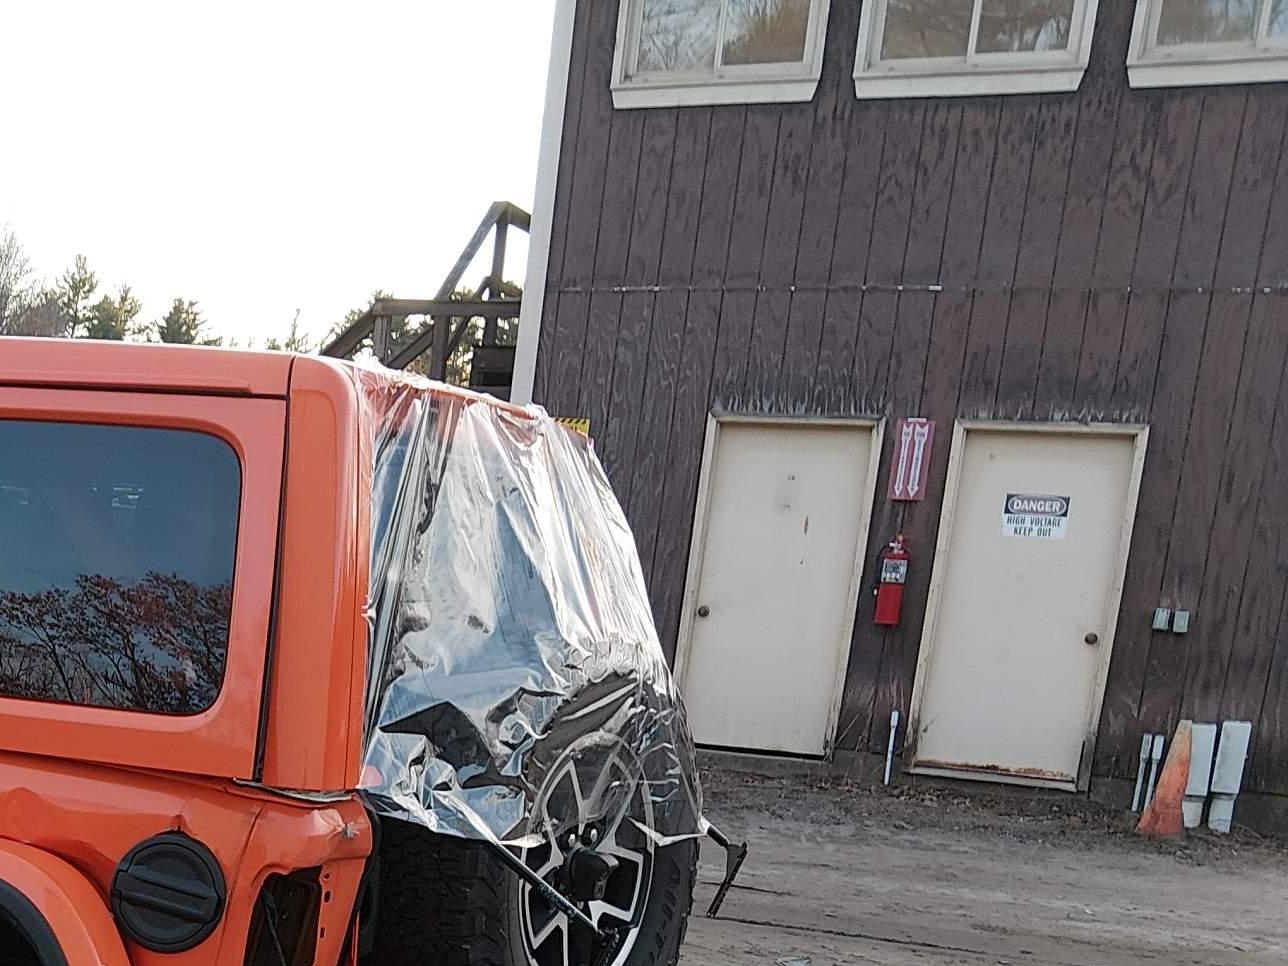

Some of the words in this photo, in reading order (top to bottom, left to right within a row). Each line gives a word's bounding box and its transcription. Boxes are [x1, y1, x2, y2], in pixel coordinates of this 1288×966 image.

[1013, 500, 1061, 513] DANGER
[1006, 515, 1026, 525] HIGH
[1030, 516, 1062, 528] VOLTAGE
[1013, 526, 1033, 537] KEEP
[1036, 528, 1052, 537] OUT
